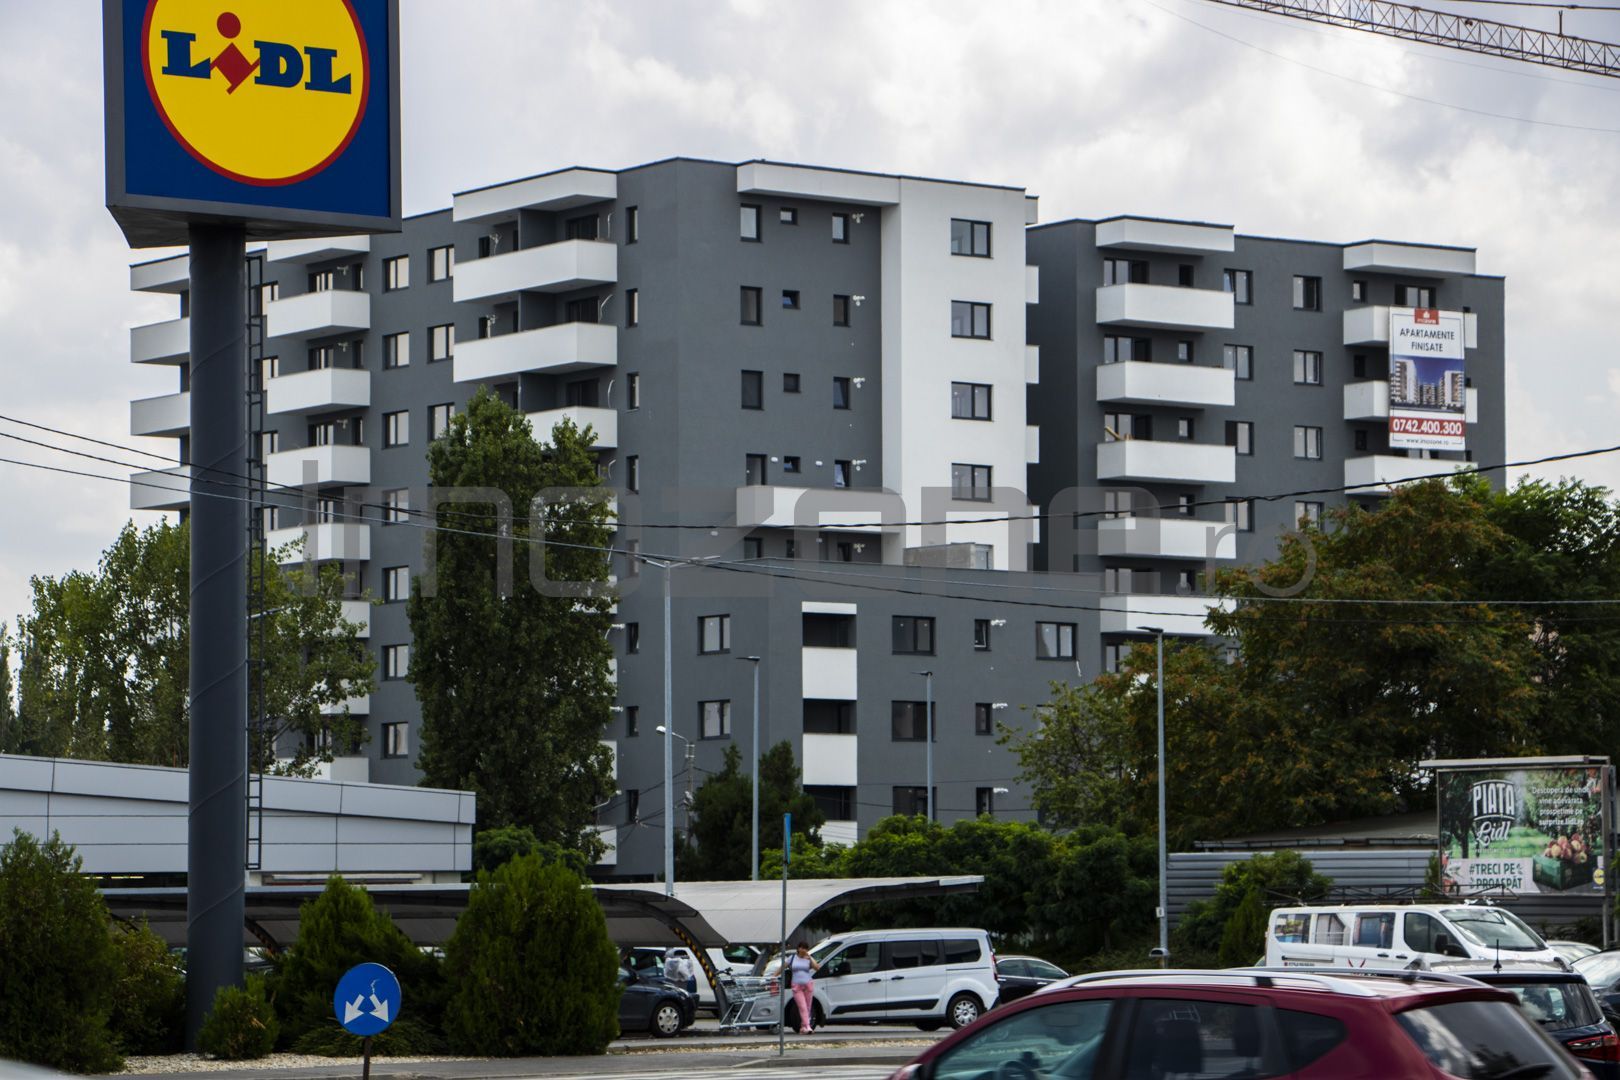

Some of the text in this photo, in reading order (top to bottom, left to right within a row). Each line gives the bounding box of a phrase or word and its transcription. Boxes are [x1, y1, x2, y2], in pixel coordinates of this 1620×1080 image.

[161, 11, 351, 95] LIDL
[1399, 327, 1455, 340] APARTAMENTE
[1411, 341, 1444, 352] FINISATE
[1392, 418, 1462, 435] 0742.400.300
[1475, 820, 1511, 847] Lidl
[1469, 863, 1515, 875] #TRECI PE
